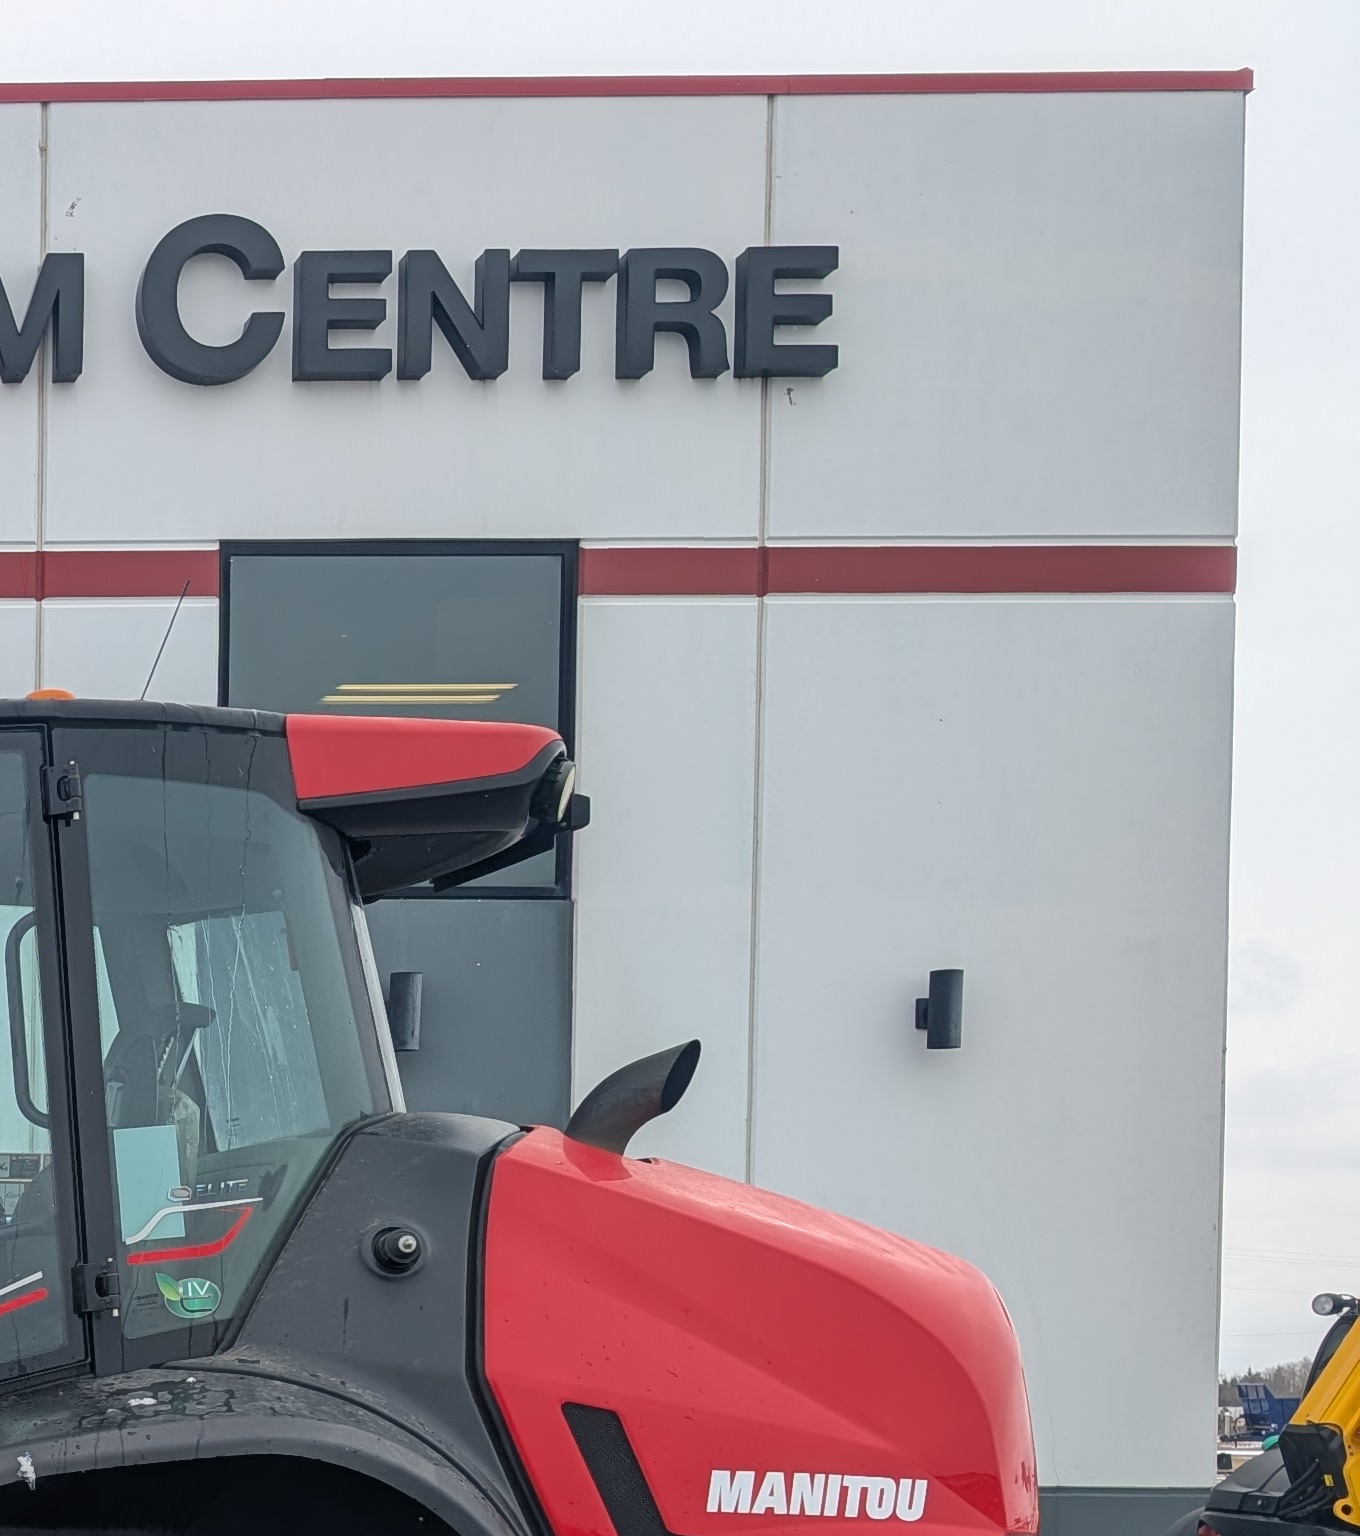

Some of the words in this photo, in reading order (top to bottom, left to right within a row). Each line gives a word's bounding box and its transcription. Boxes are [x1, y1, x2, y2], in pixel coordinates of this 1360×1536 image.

[135, 212, 840, 386] CENTRE
[195, 1178, 249, 1197] ELITE
[706, 1470, 928, 1522] MANITOU
